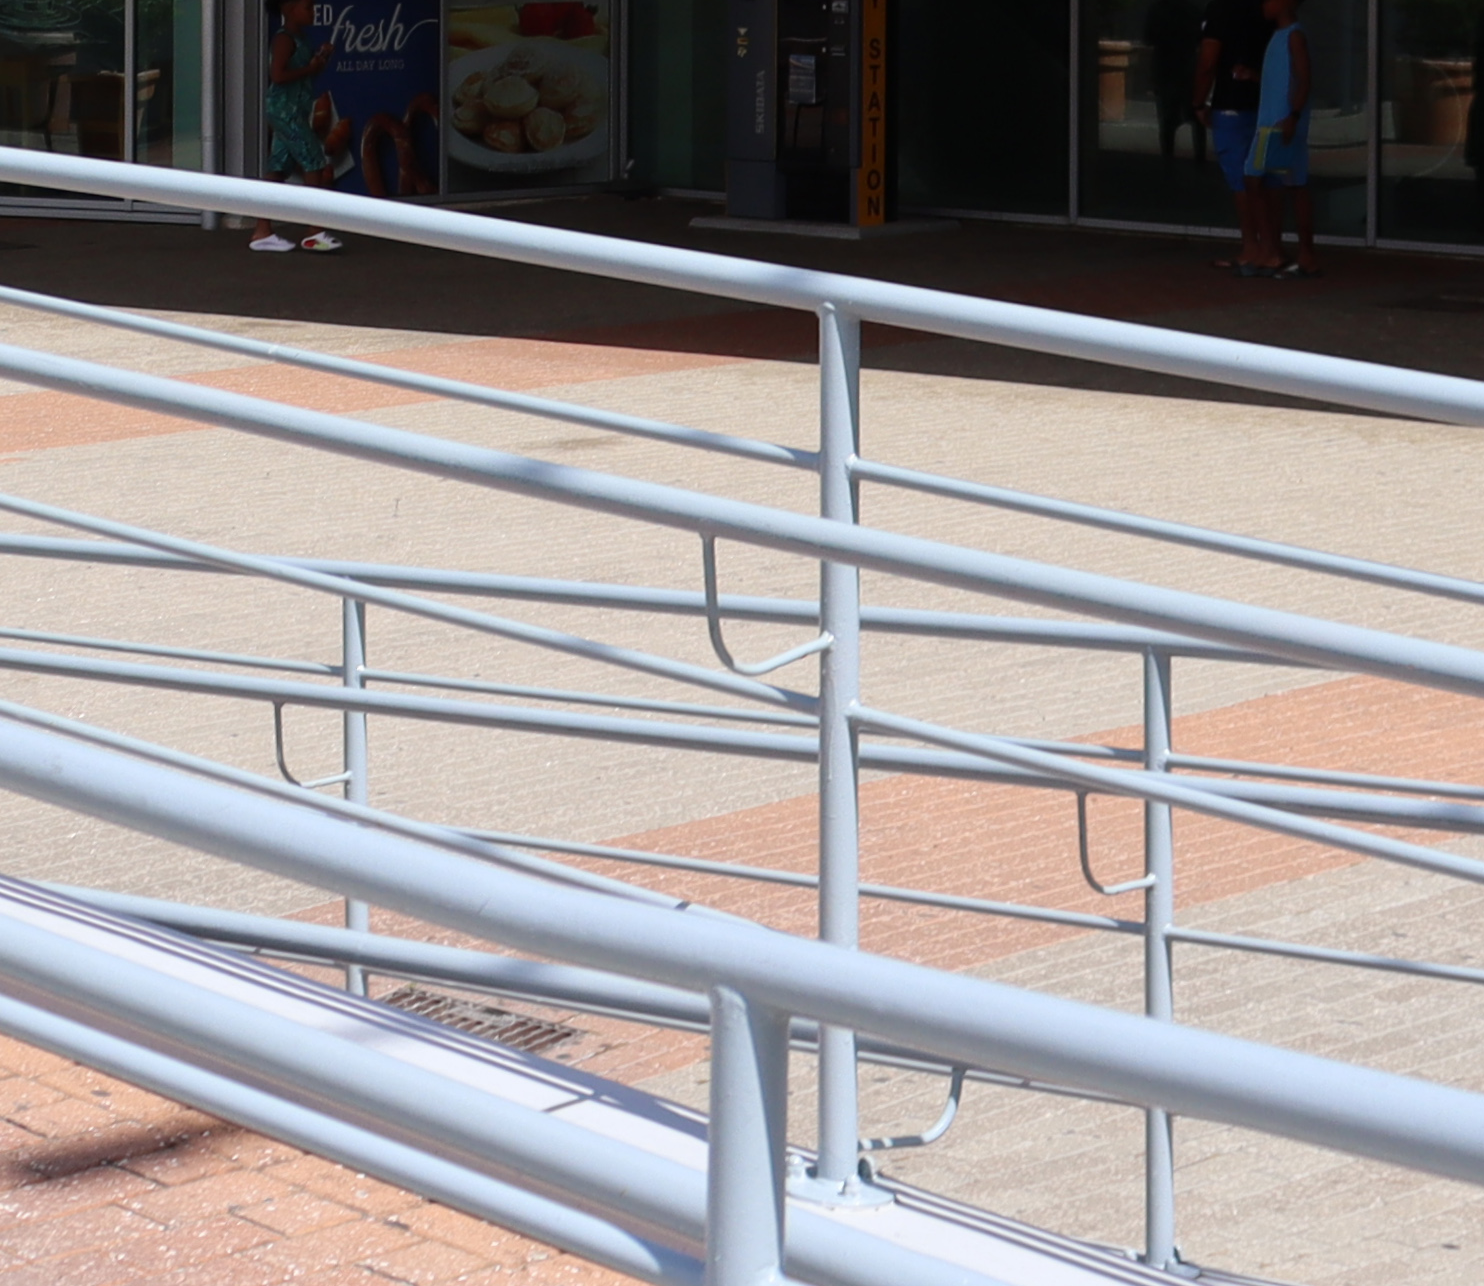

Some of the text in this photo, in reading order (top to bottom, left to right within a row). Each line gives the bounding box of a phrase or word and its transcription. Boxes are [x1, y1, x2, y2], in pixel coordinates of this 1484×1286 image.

[330, 2, 438, 53] fresh
[336, 58, 405, 73] ALL DAY LONG
[868, 38, 882, 217] STATION
